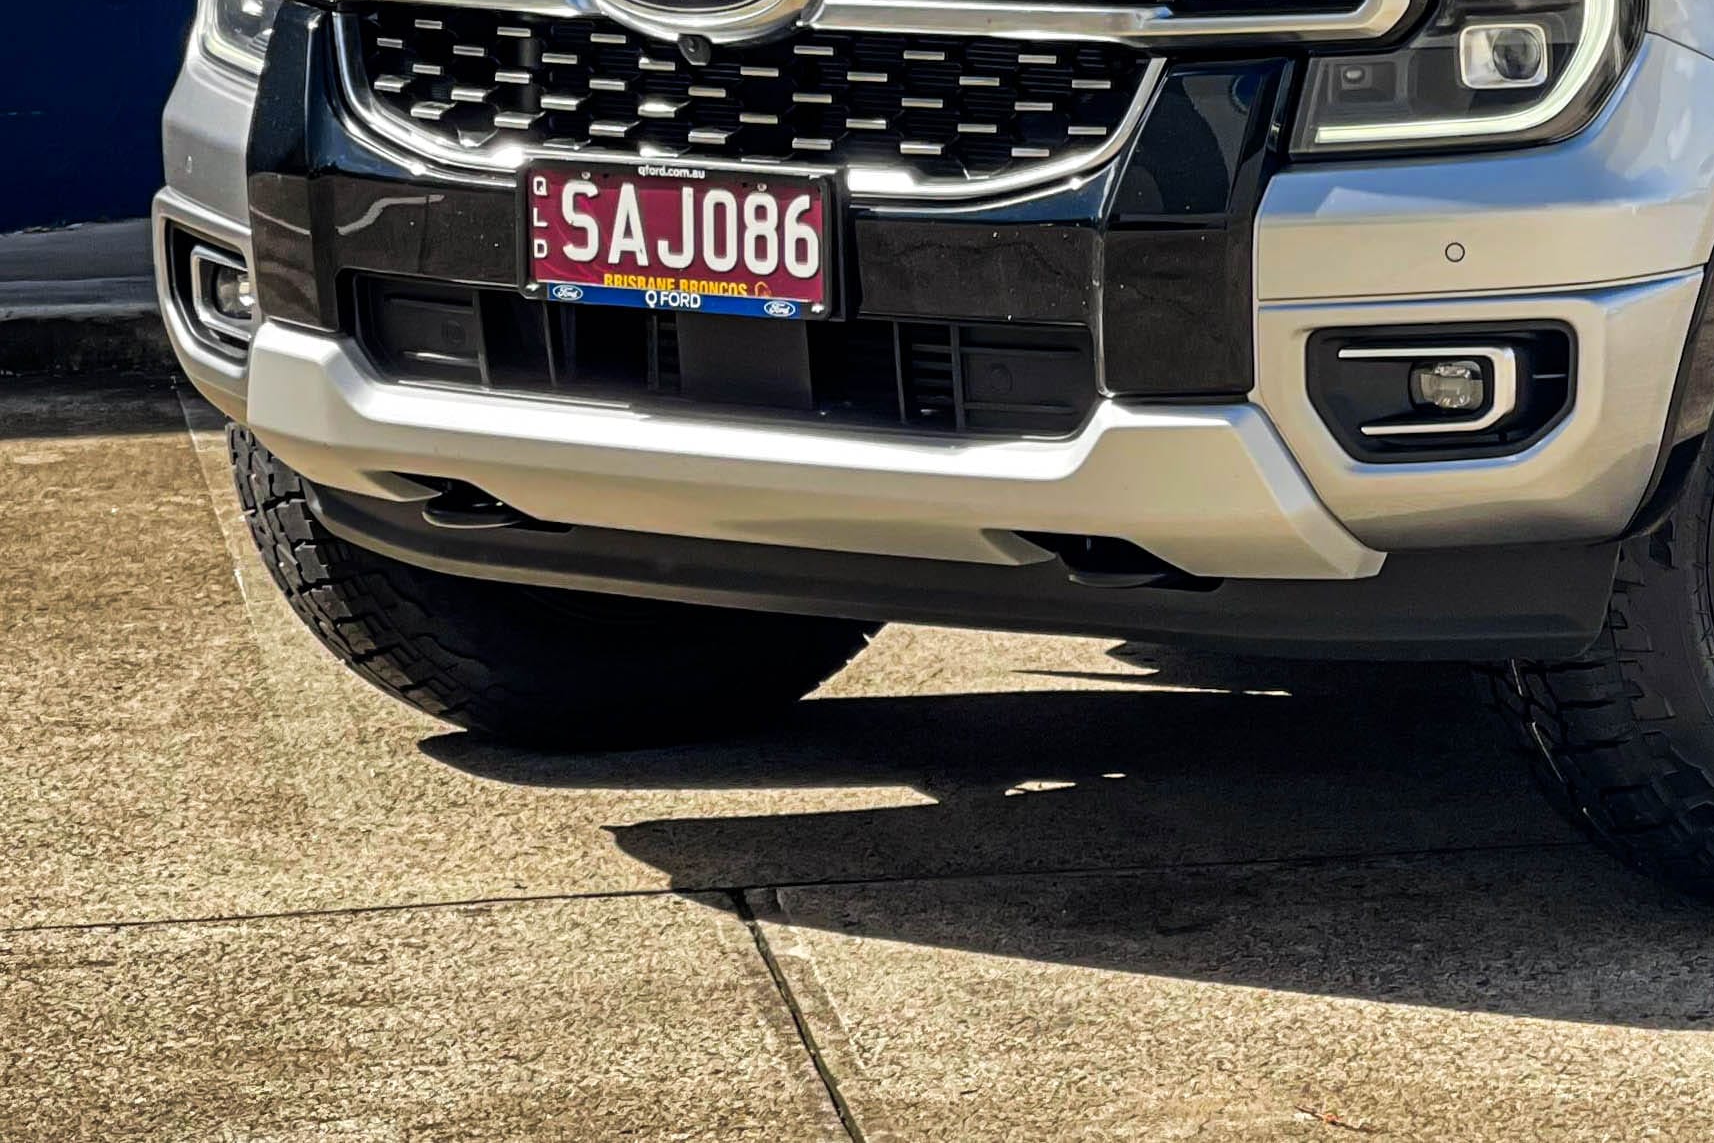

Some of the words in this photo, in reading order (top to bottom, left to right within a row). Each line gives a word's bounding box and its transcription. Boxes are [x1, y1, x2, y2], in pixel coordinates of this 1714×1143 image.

[637, 165, 706, 180] qford.com.au
[561, 180, 819, 279] SAJ086
[644, 289, 657, 308] Q
[660, 291, 701, 309] FORD
